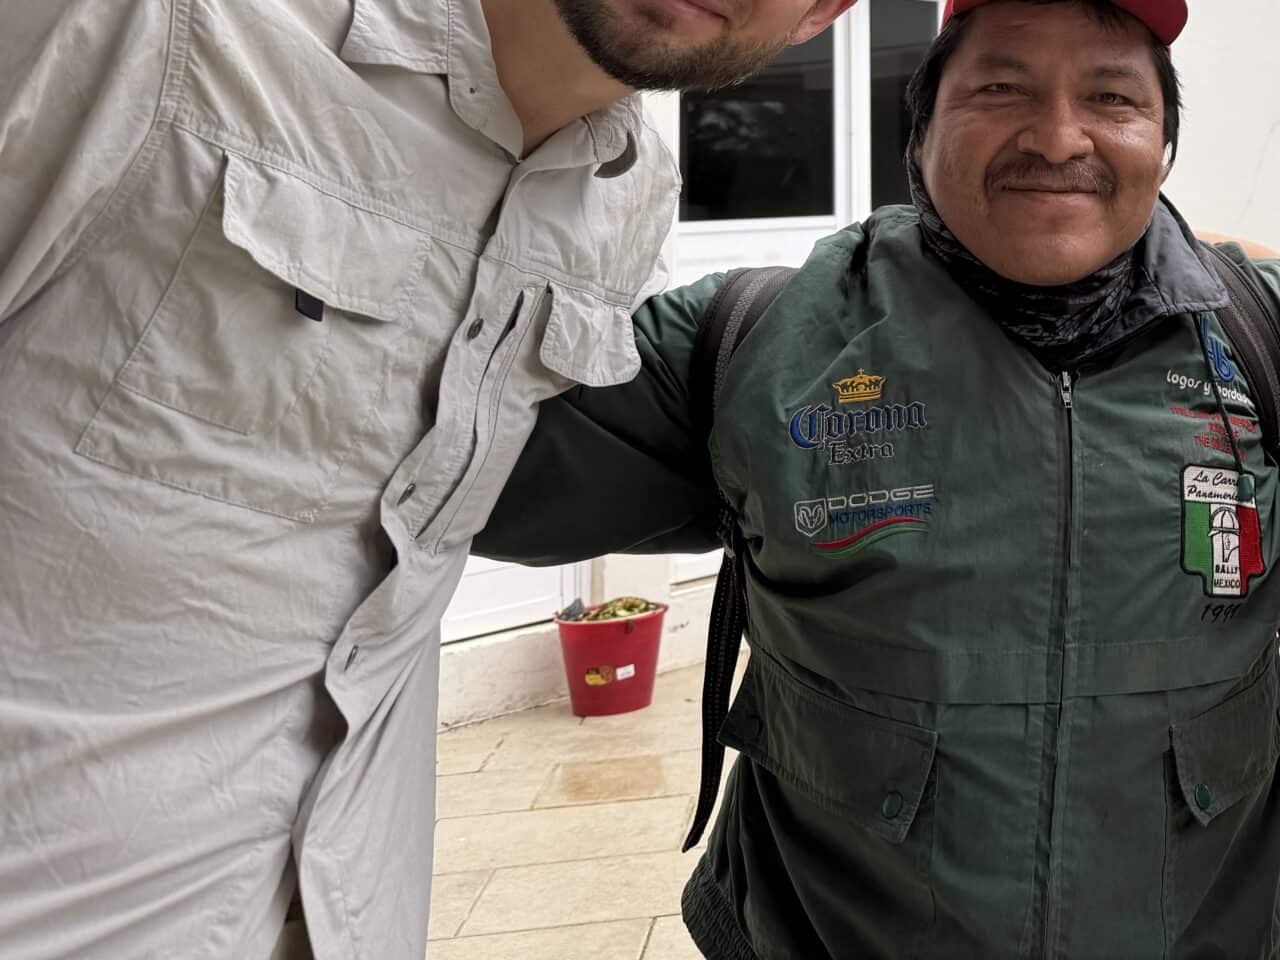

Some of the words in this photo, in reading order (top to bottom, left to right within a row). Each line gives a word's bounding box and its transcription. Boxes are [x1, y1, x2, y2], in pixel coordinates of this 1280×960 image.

[1203, 381, 1212, 396] y
[789, 400, 928, 451] Corona
[828, 440, 895, 465] Extra
[1192, 470, 1210, 483] La
[827, 483, 935, 510] DODGE
[828, 502, 933, 526] MOTORSPORTS
[1215, 564, 1239, 575] RALLY
[1213, 579, 1241, 589] MEXICO
